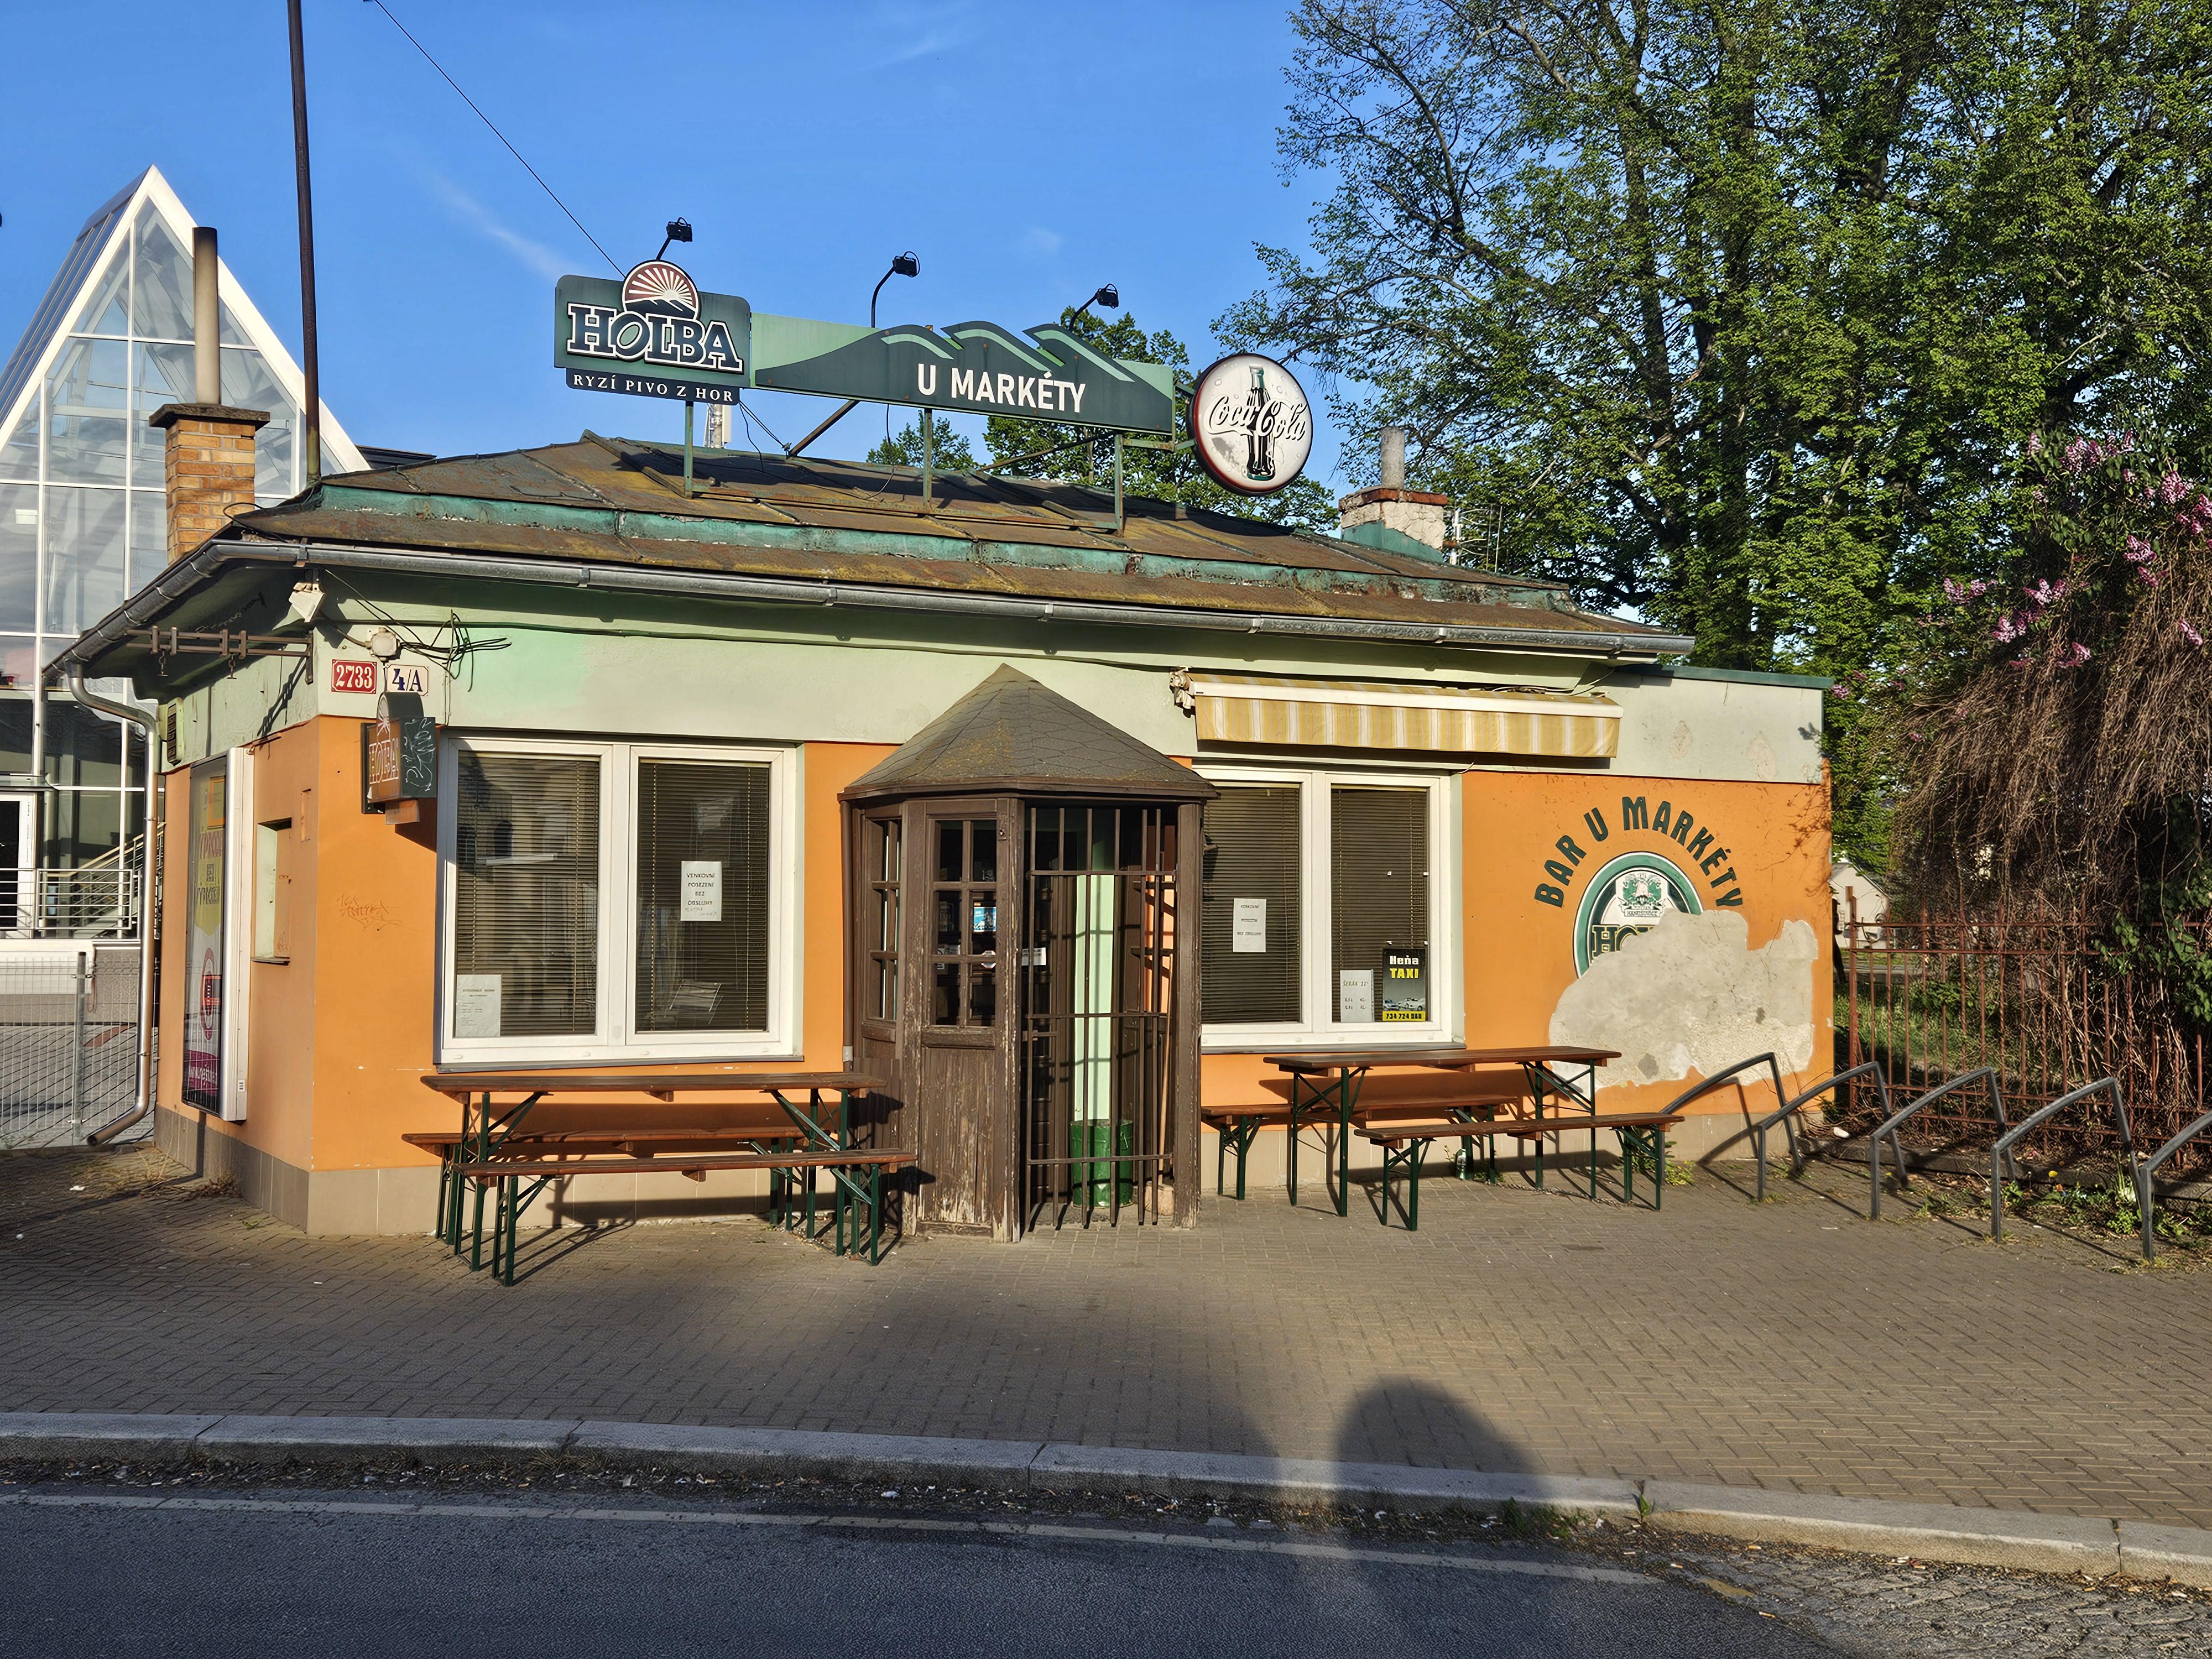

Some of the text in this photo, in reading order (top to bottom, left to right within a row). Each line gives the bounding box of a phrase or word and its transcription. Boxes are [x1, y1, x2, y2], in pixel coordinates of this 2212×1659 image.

[567, 302, 742, 373] HOLBA
[573, 373, 733, 402] RYZÍ PIVO Z HOR
[917, 363, 1086, 413] U MARKÉTY
[336, 664, 372, 688] 2733
[392, 668, 422, 692] 4/A
[1534, 796, 1743, 907] BAR U MARKÉTY
[1389, 968, 1418, 979] TAXI
